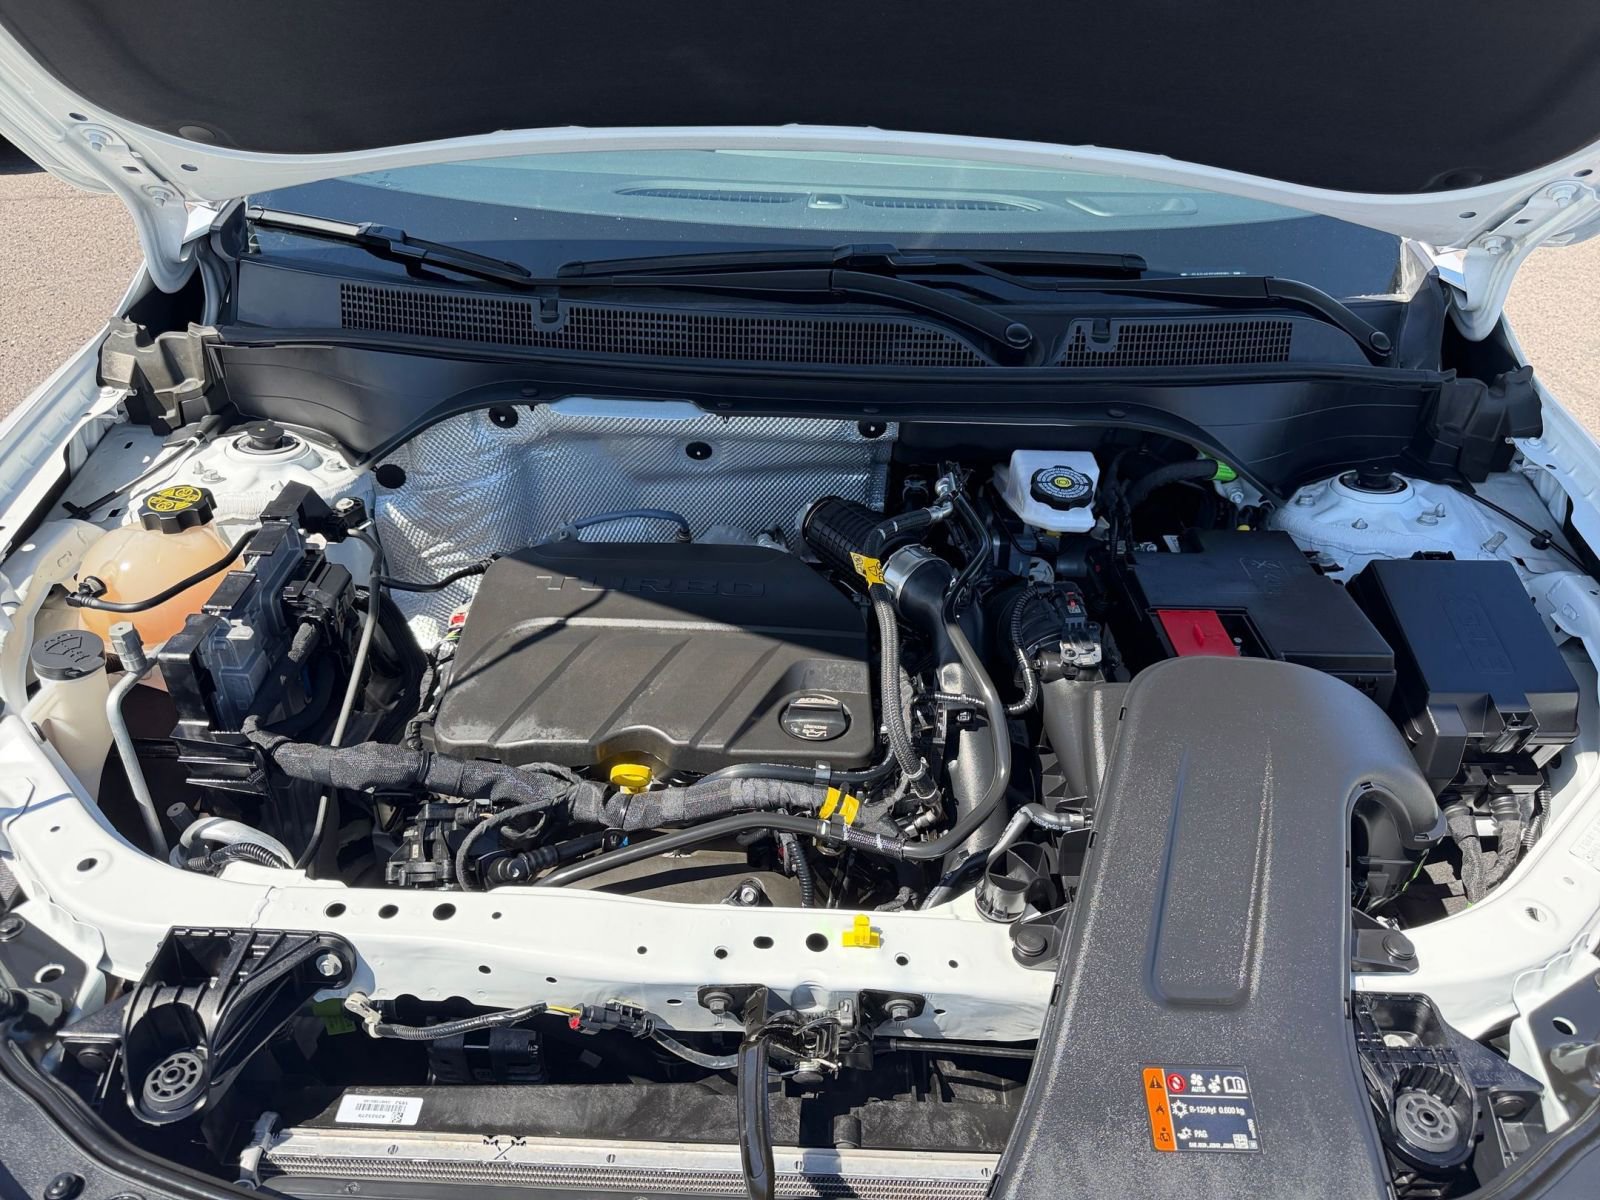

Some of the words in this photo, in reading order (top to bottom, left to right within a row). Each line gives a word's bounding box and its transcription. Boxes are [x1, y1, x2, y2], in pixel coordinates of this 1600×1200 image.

[536, 575, 766, 597] TURBO
[1189, 1105, 1217, 1115] R-1234yf
[1237, 1107, 1245, 1115] kg
[1193, 1129, 1209, 1138] PAG
